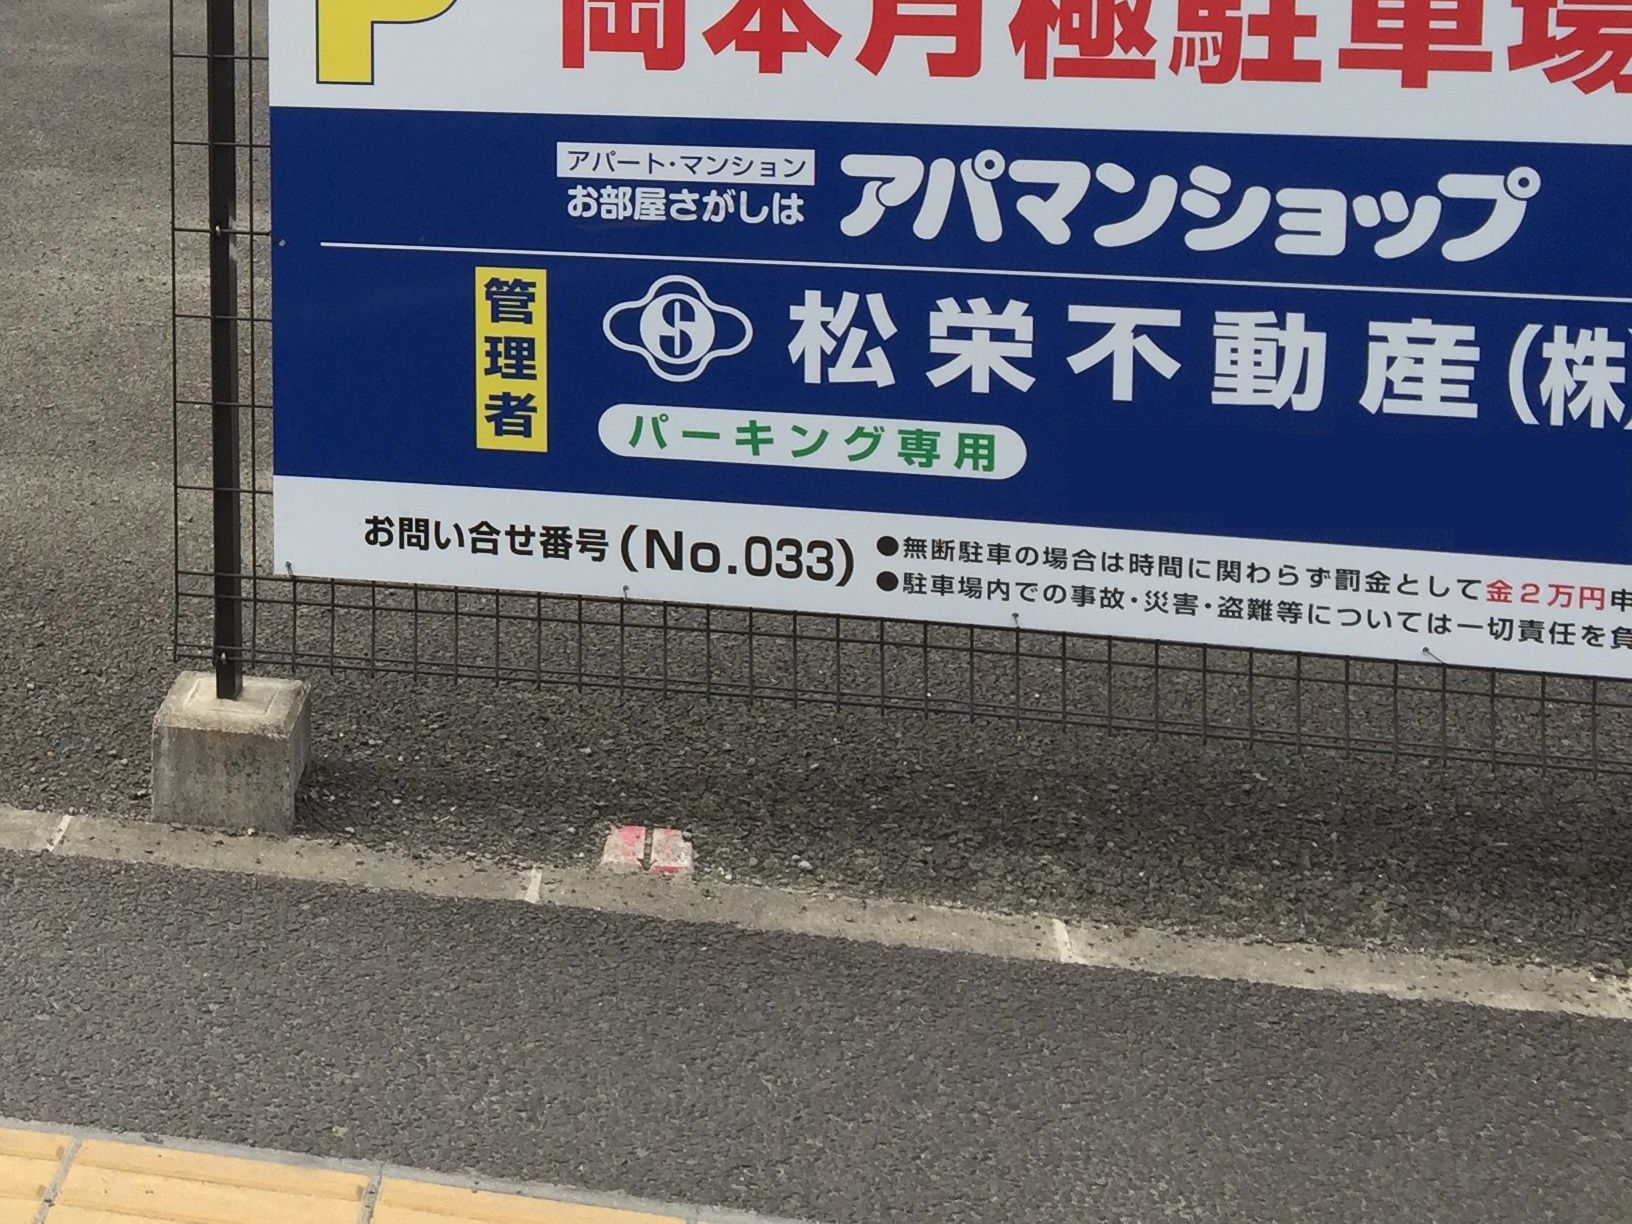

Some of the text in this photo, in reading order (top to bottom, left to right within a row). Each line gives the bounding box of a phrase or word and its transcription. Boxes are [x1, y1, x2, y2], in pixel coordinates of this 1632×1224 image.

[567, 184, 805, 225] お部屋さがしは
[568, 150, 807, 178] アパート・マンション
[839, 148, 1542, 263] アパマンショップ
[483, 277, 538, 439] 管理者
[787, 289, 1632, 431] 松栄不動産(株
[628, 413, 996, 473] パーキング専用
